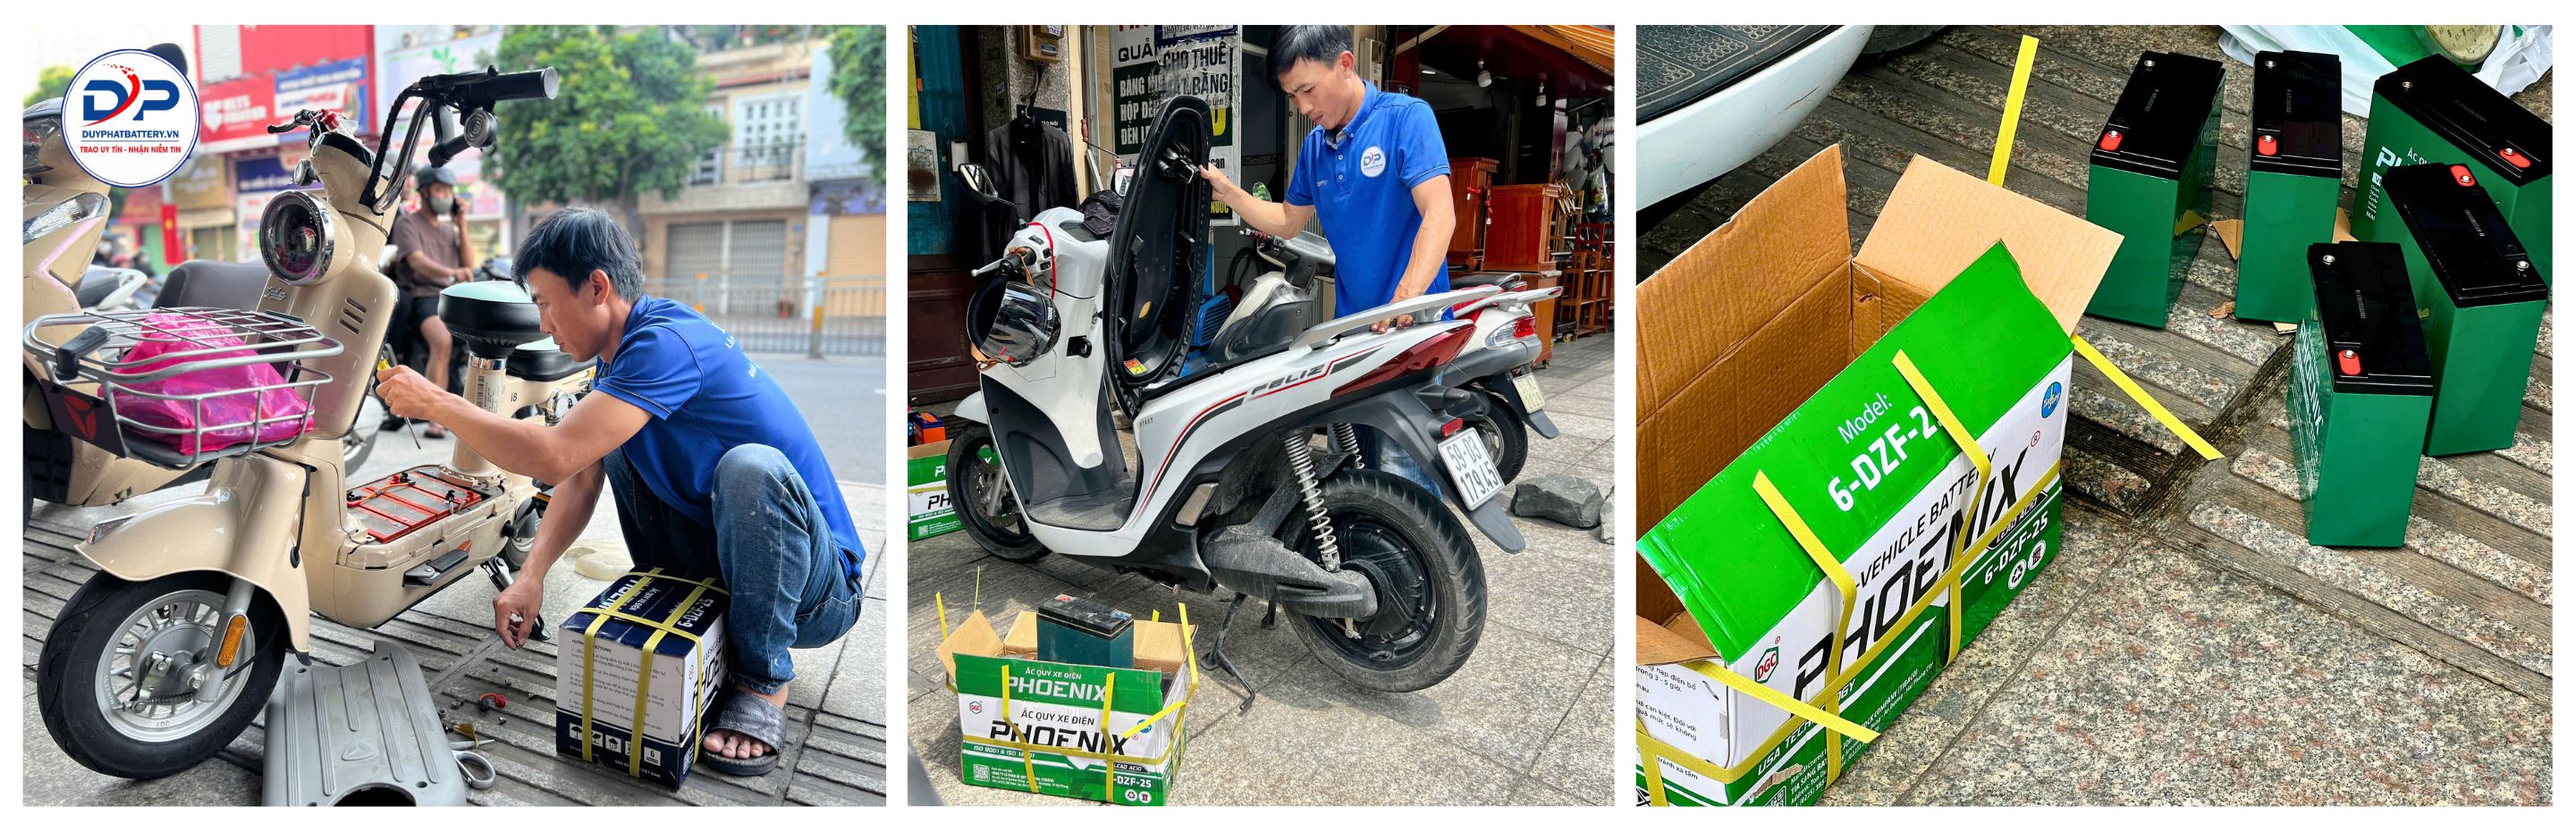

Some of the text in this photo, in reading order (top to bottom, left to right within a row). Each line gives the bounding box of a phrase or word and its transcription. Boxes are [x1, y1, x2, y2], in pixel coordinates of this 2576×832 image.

[1119, 38, 1153, 62] QUẢ
[1163, 41, 1227, 71] CHO THUÊ
[1120, 75, 1145, 97] BẢNG
[1120, 101, 1139, 123] HỘP
[1121, 125, 1138, 146] ĐÈN
[1251, 364, 1325, 395] FELIZ
[1837, 392, 1893, 444] Model:
[1828, 405, 1941, 512] 6-DZF-2
[1855, 513, 1926, 588] -VEHICLE
[1984, 510, 2049, 585] 6-DZF-25
[1790, 445, 2030, 719] PHOENIX
[677, 598, 714, 628] 6-DZF-25
[1036, 669, 1052, 677] QUY
[1636, 665, 1654, 679] trong
[1757, 652, 1778, 680] DGC
[1008, 677, 1106, 702] PHOENIX
[1035, 710, 1055, 722] QUY
[1057, 713, 1069, 723] XE
[1071, 716, 1095, 727] ĐIỆN
[609, 743, 618, 751] UP
[990, 719, 1129, 756] PHOENIX
[1657, 756, 1675, 769] tránh
[1676, 765, 1685, 774] xa
[1758, 746, 1781, 776] USA
[1113, 775, 1152, 788] -DZF-25
